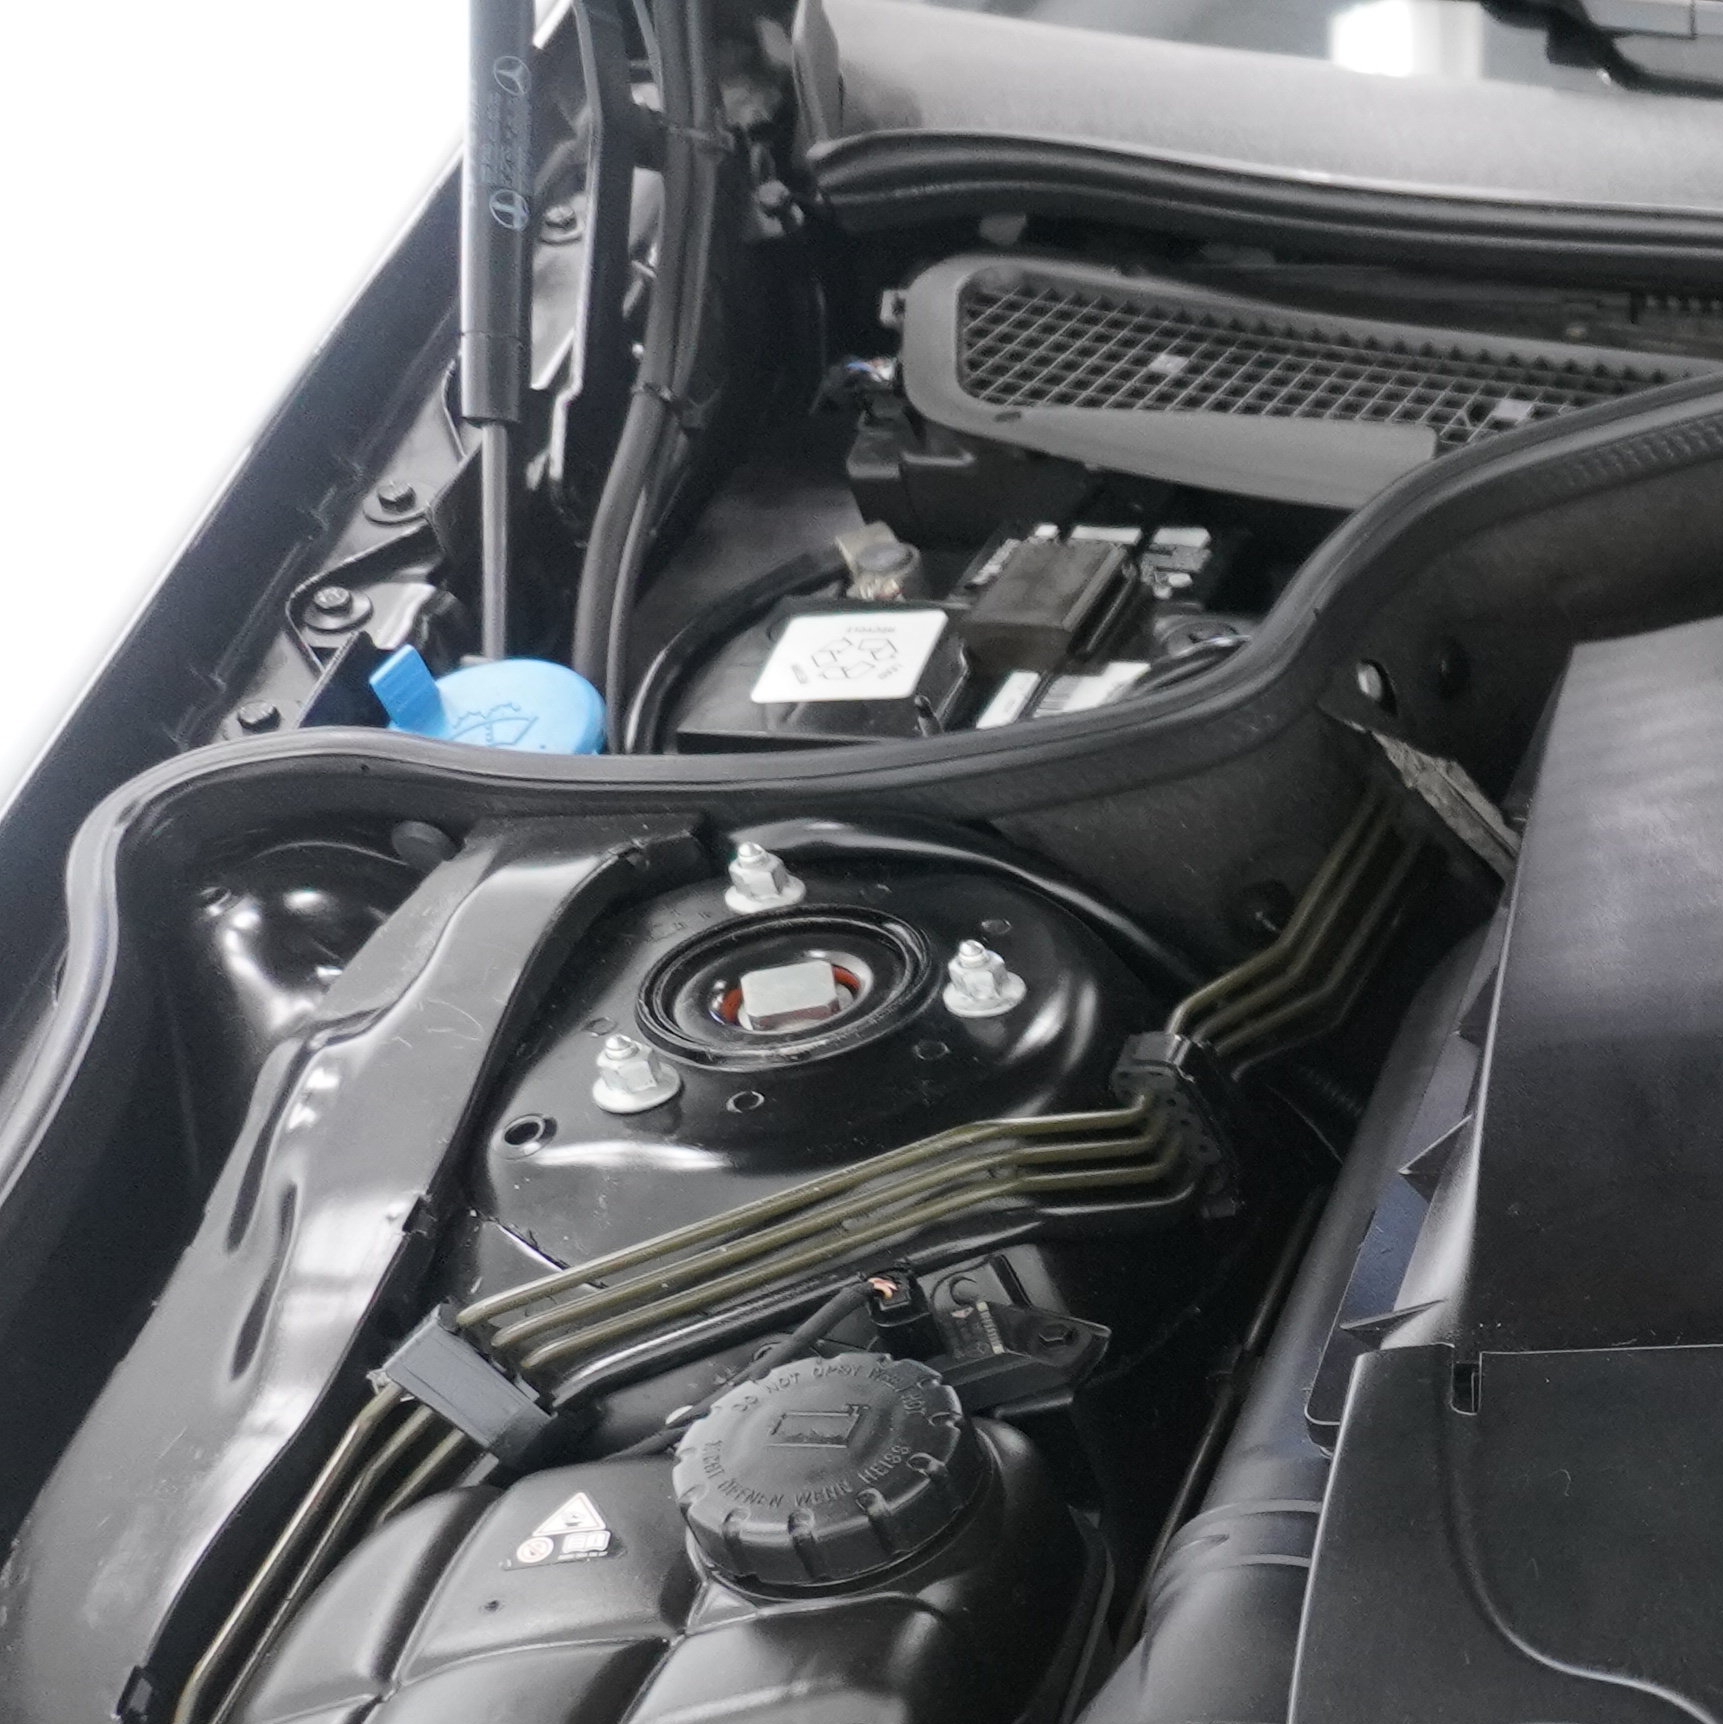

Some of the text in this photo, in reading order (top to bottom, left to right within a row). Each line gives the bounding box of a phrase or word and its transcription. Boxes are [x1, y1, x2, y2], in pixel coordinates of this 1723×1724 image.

[767, 1371, 800, 1394] NOT
[794, 1479, 854, 1507] WENN
[857, 1443, 912, 1485] HEISS
